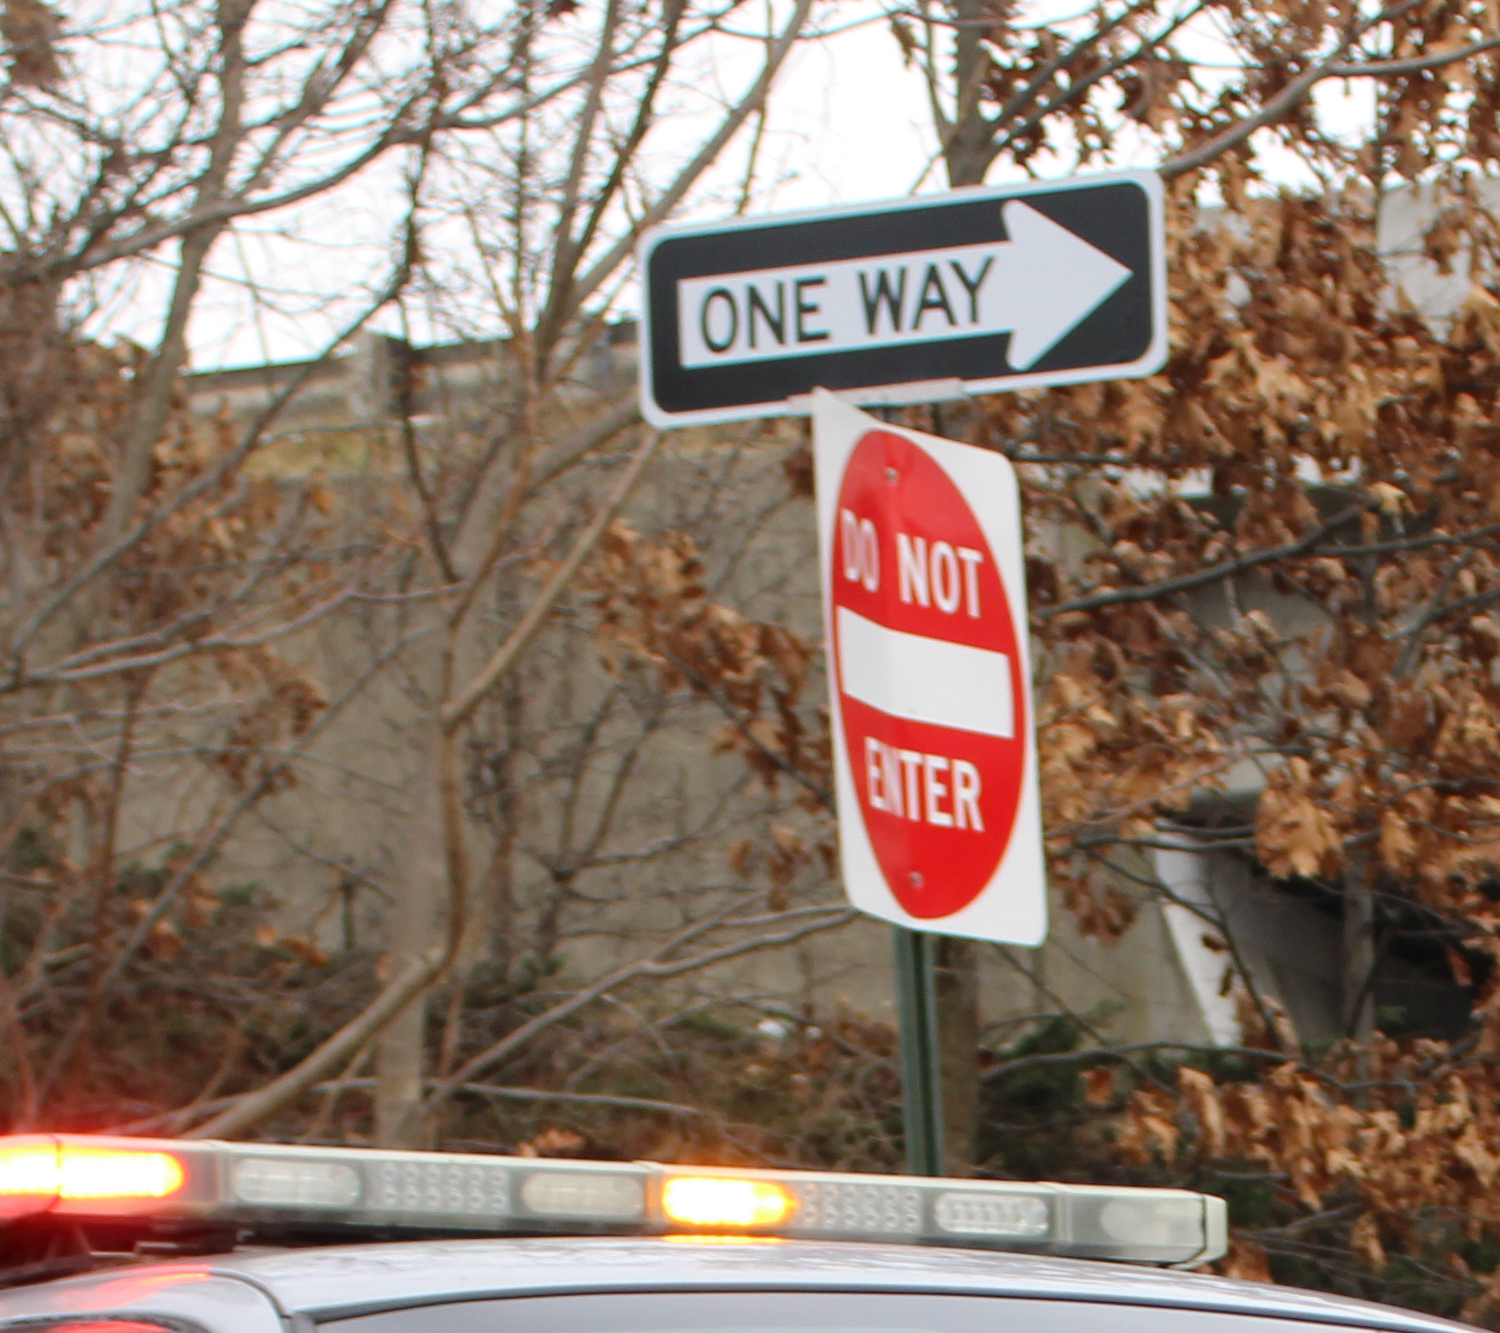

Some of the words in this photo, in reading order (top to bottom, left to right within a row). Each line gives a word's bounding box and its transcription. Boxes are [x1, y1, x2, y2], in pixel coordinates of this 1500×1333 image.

[700, 276, 831, 353] ONE
[859, 256, 997, 336] WAY
[841, 510, 881, 592] DO
[898, 532, 984, 619] NOT
[864, 735, 986, 833] ENTER
